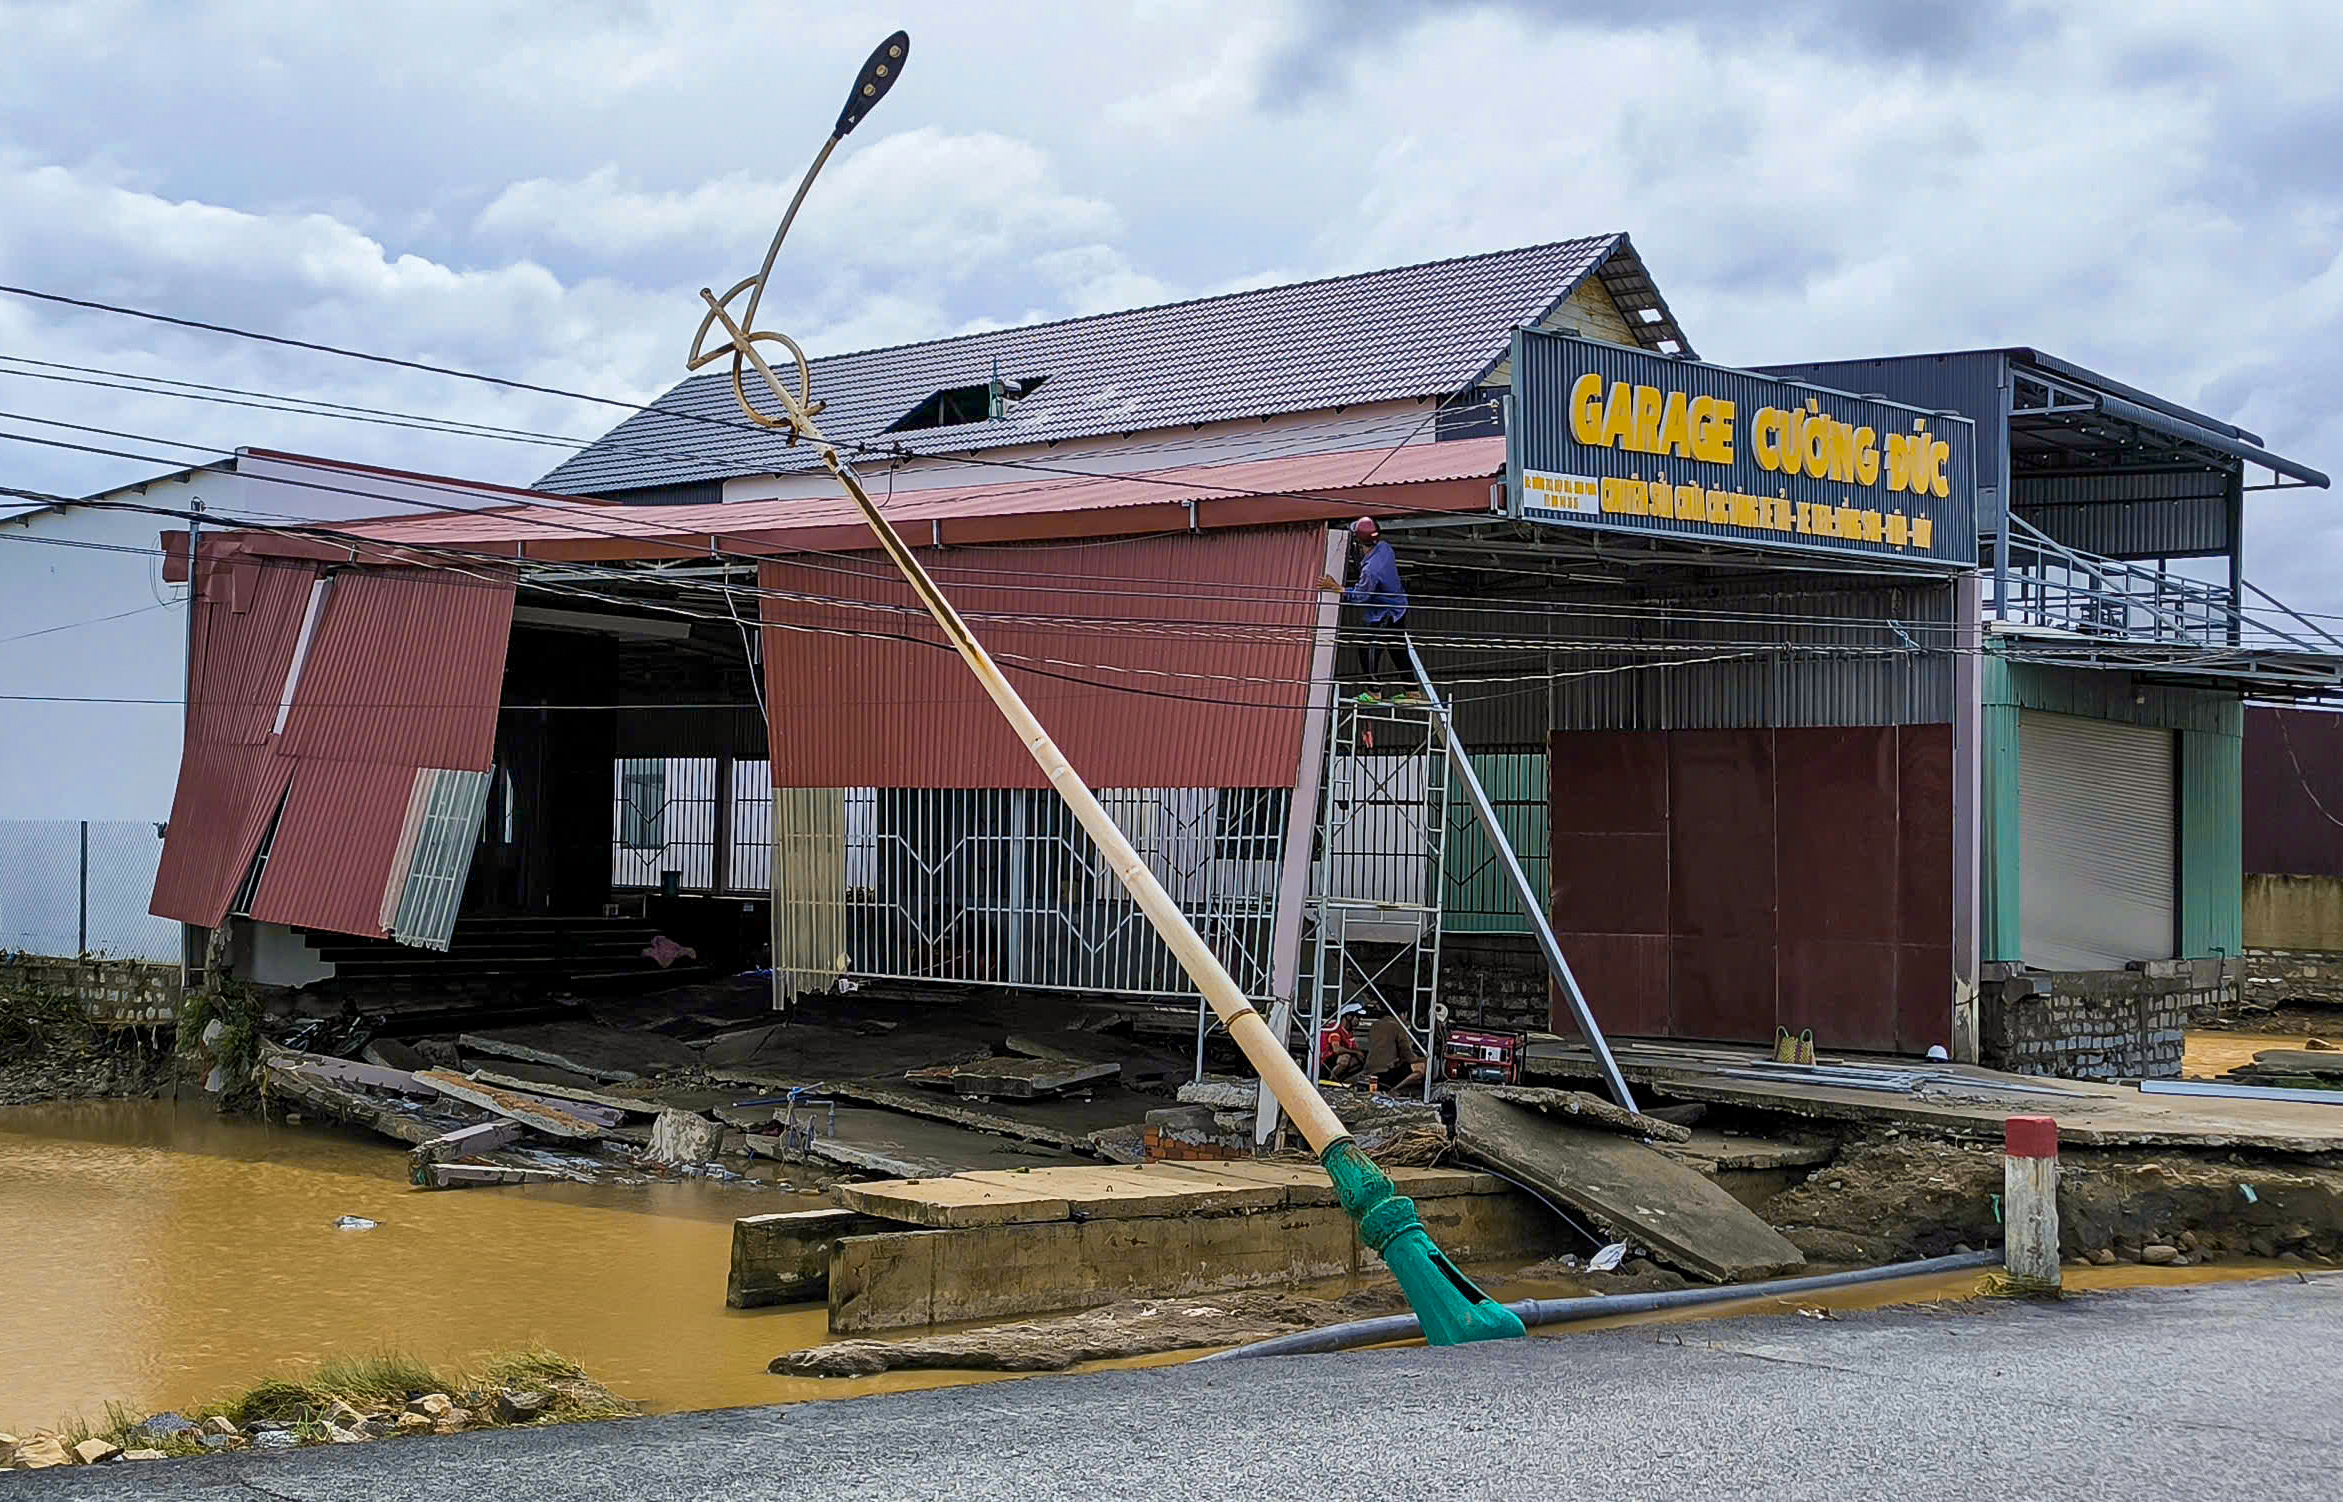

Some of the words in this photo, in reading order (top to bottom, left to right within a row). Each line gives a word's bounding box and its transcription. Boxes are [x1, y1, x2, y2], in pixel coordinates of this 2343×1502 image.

[1569, 373, 1735, 464] GARAGE
[1752, 398, 1880, 486] CƯỜNG
[1884, 418, 1950, 498] ĐỨC
